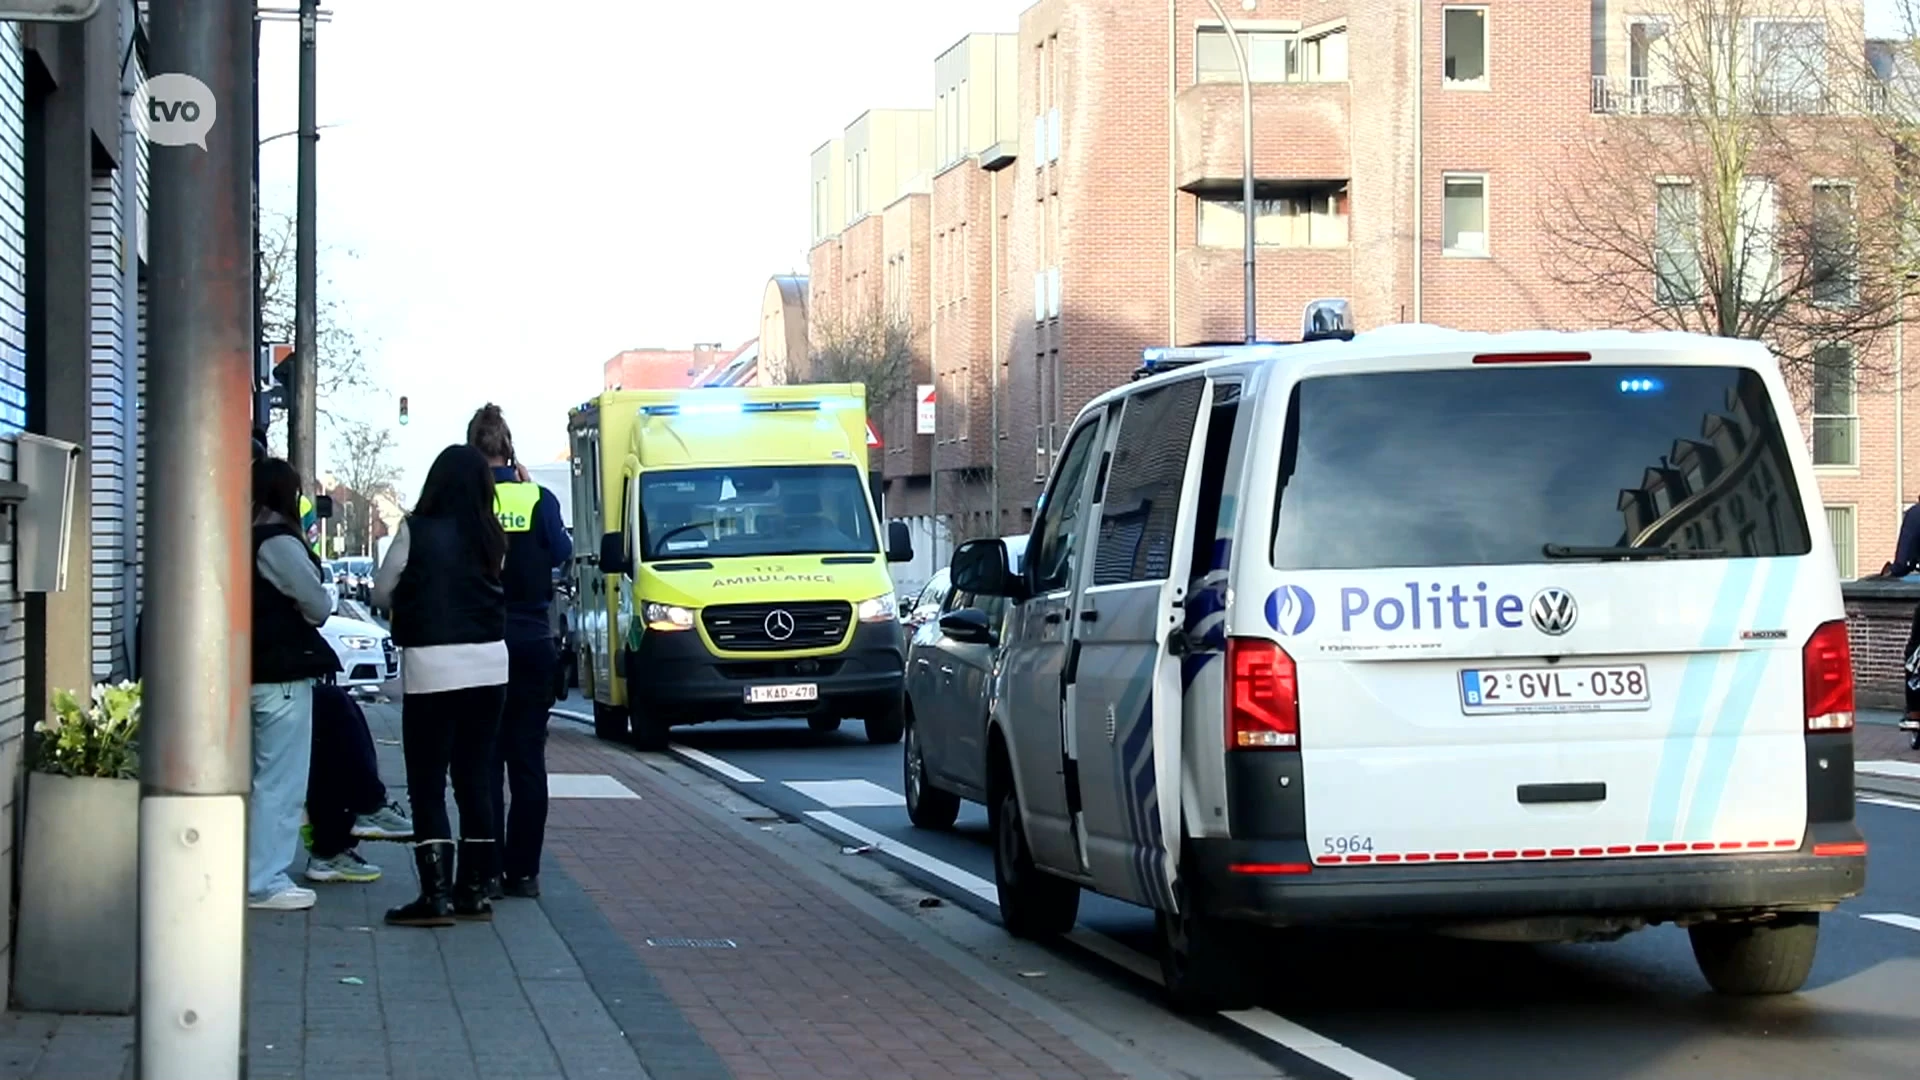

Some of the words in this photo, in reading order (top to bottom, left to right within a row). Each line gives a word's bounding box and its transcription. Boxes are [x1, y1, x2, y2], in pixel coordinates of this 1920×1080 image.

[495, 511, 526, 528] tie
[712, 574, 836, 588] AMBULANCE
[1340, 581, 1524, 633] Politie
[1467, 689, 1479, 704] B
[1324, 834, 1374, 854] 5964
